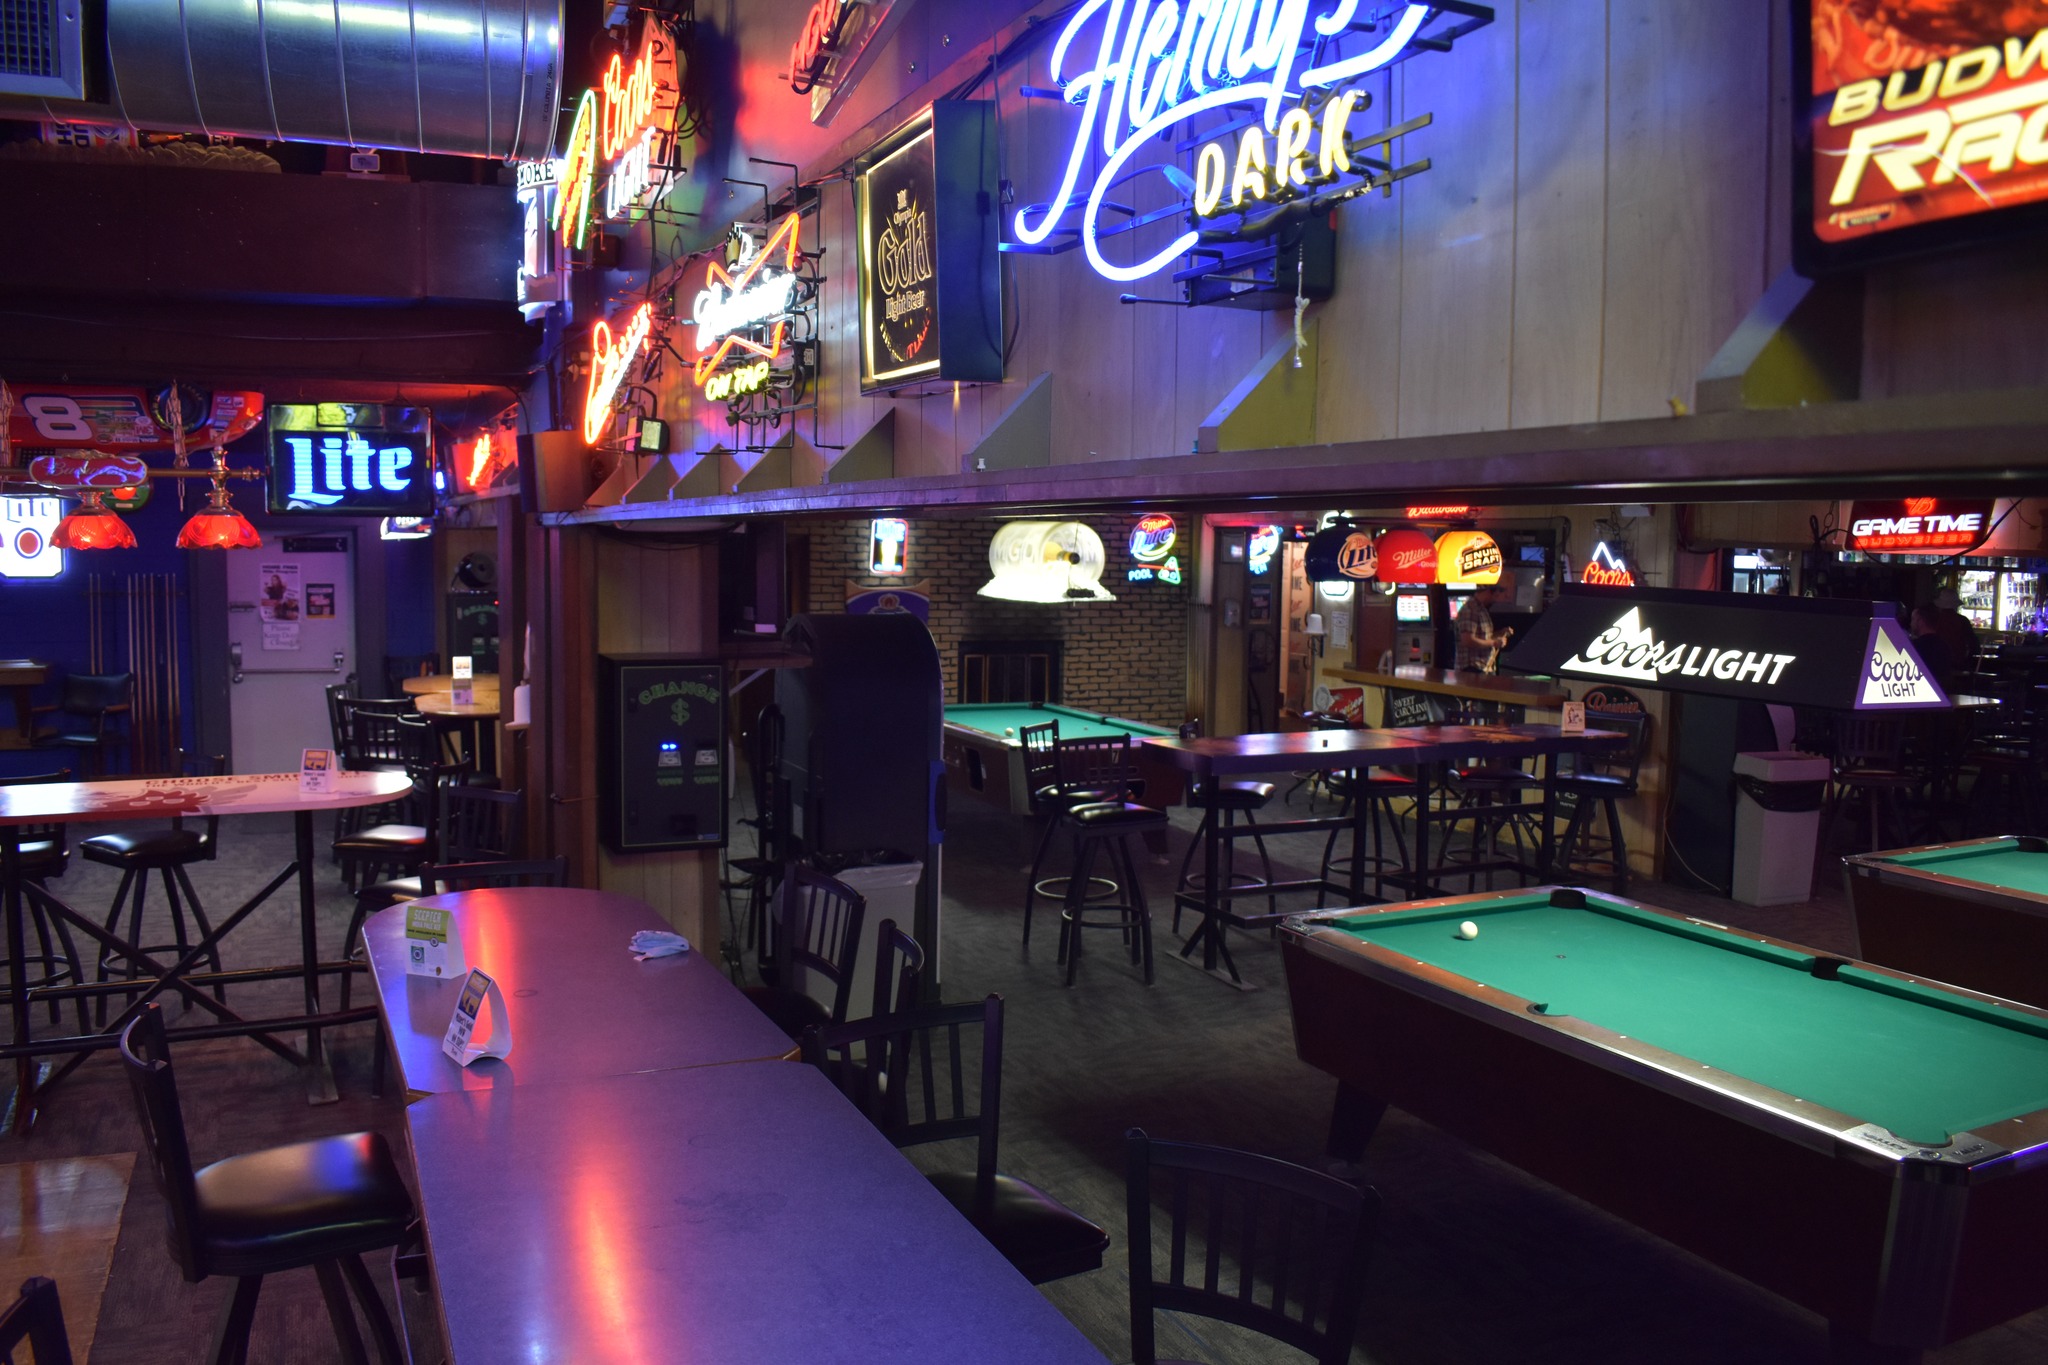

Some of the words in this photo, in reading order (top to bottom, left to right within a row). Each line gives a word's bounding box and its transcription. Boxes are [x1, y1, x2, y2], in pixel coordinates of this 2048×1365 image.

[1195, 90, 1360, 217] DARK
[606, 125, 657, 220] LIGHT
[877, 211, 932, 295] Gold
[885, 293, 907, 322] Light
[906, 290, 925, 312] Beer
[705, 373, 732, 401] ON
[733, 361, 769, 394] TAP
[23, 395, 94, 441] 8
[285, 437, 413, 505] Lite
[1141, 519, 1171, 533] Miller
[1852, 516, 1922, 537] GAME
[1923, 513, 1982, 533] TIME
[1130, 527, 1174, 554] Lite
[1392, 548, 1433, 569] Miller
[1464, 555, 1500, 570] DRAFT
[1128, 569, 1153, 581] POOL
[1583, 561, 1631, 586] Coors
[1584, 626, 1684, 675] Coors
[1681, 648, 1796, 685] LIGHT
[1869, 651, 1924, 682] Coors
[638, 681, 720, 705] CHANGE
[1393, 695, 1416, 709] SWEET
[1881, 682, 1916, 698] LIGHT
[145, 775, 239, 786] CHOOSE
[413, 909, 442, 923] SCEPTER
